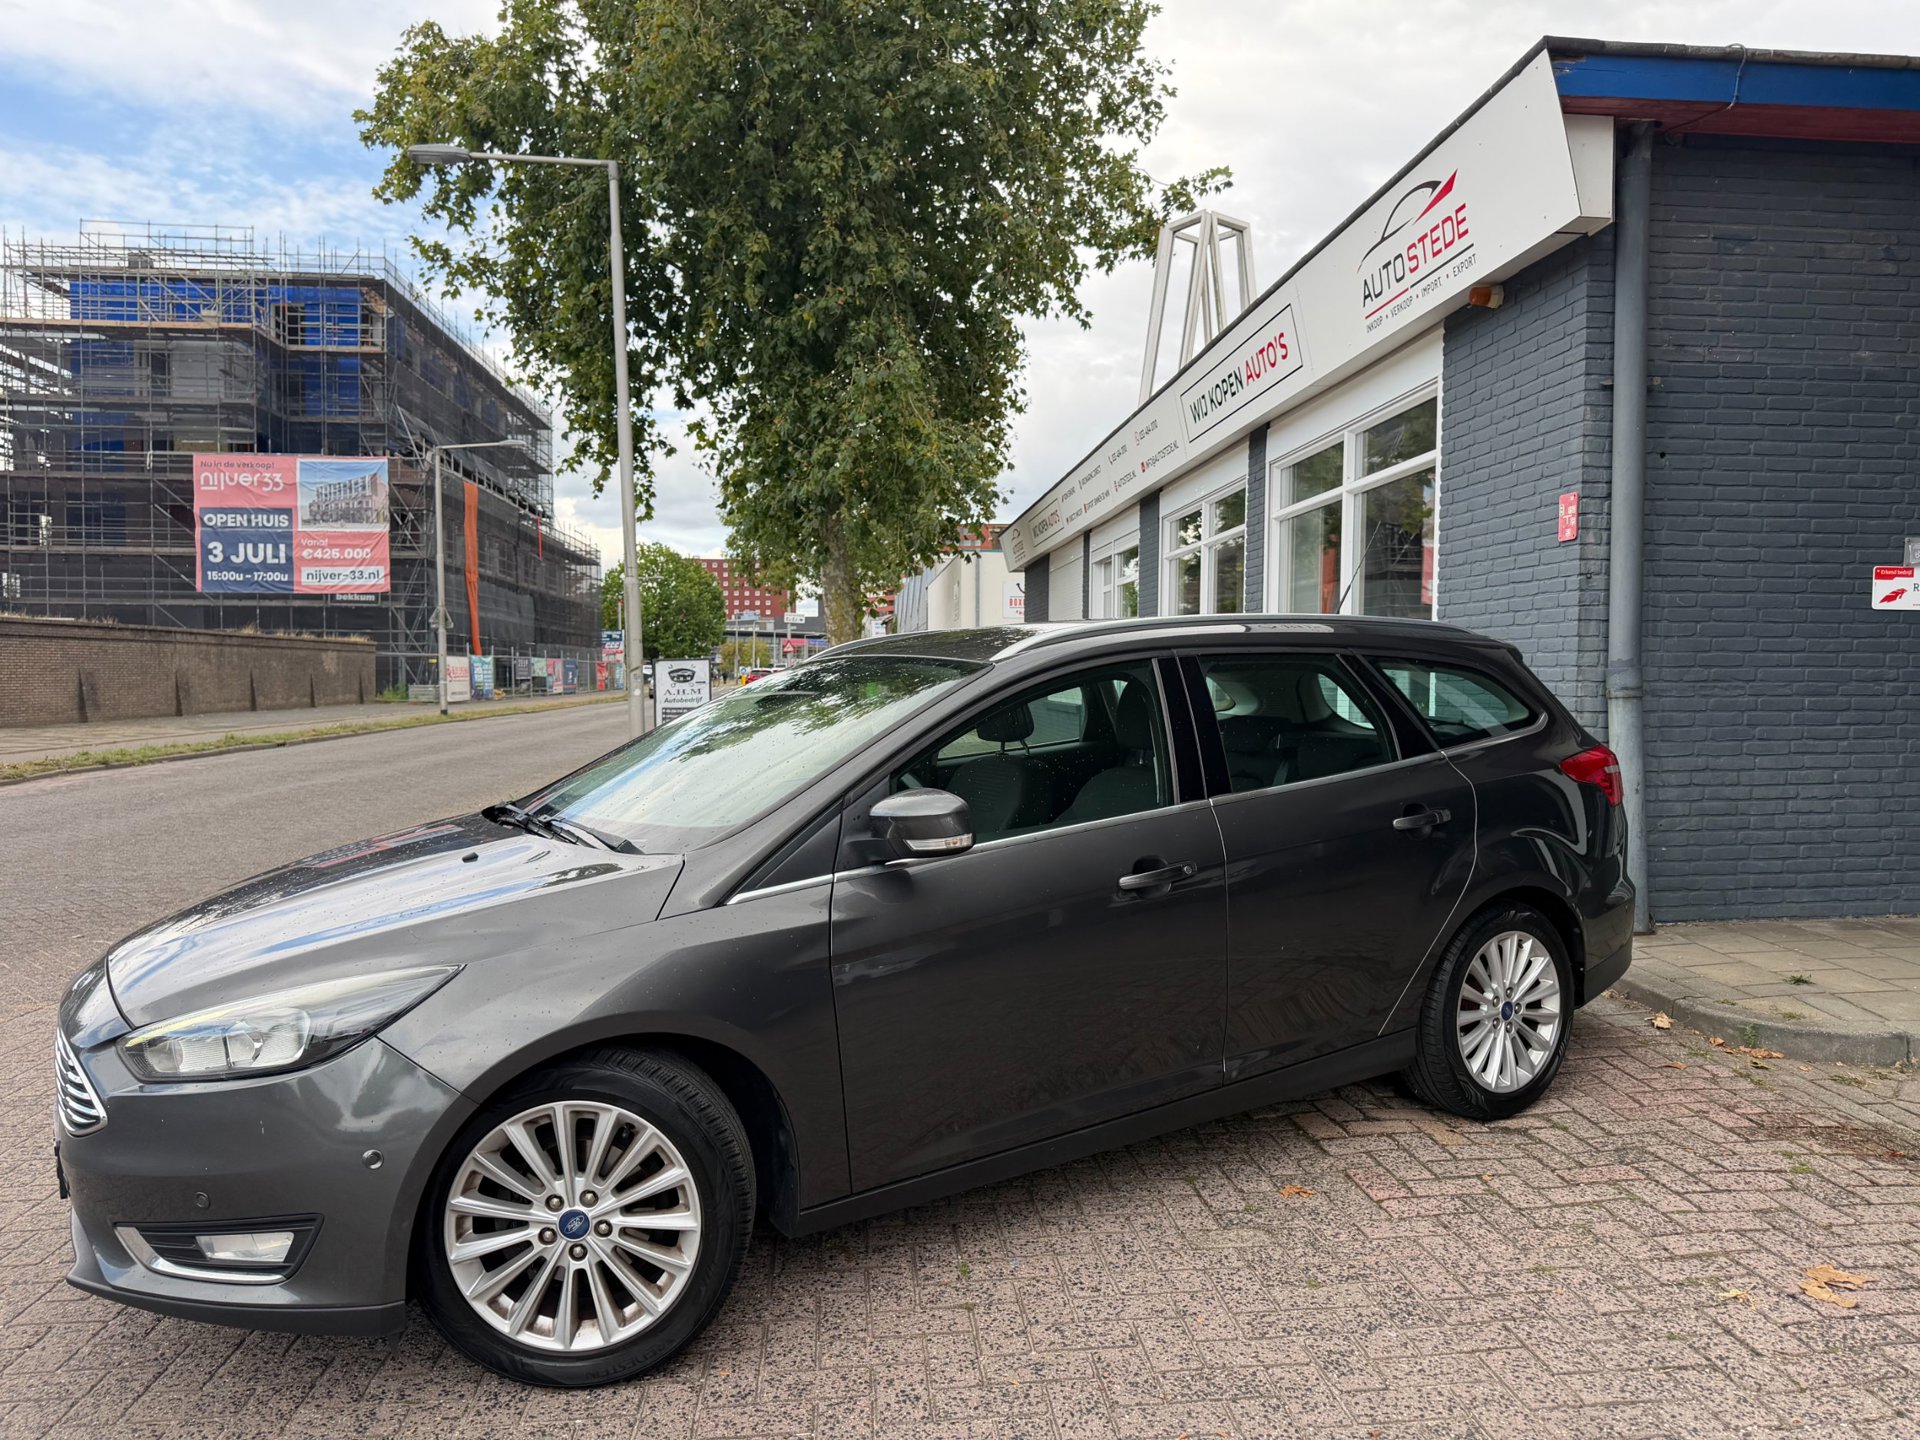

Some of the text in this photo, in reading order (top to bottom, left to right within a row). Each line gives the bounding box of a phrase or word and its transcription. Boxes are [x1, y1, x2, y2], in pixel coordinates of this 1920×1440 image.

[1366, 253, 1477, 333] INKOOP VERKOOP IMPORT EXPORT
[1189, 332, 1289, 424] WIJ KOPEN AUTO'S
[213, 460, 222, 468] in
[236, 461, 275, 470] verkoop!
[203, 513, 289, 528] OPEN HUIS
[301, 537, 329, 546] Vanaf
[207, 541, 287, 564] 3 JULI
[302, 548, 372, 559] €425.000
[207, 570, 243, 581] 15:00u
[253, 571, 288, 582] 17:00u
[306, 569, 380, 583] nijver-33.nl
[664, 688, 702, 696] A.H.M
[663, 696, 704, 704] Autobedrijf
[585, 1339, 676, 1380] REDESTEIN
